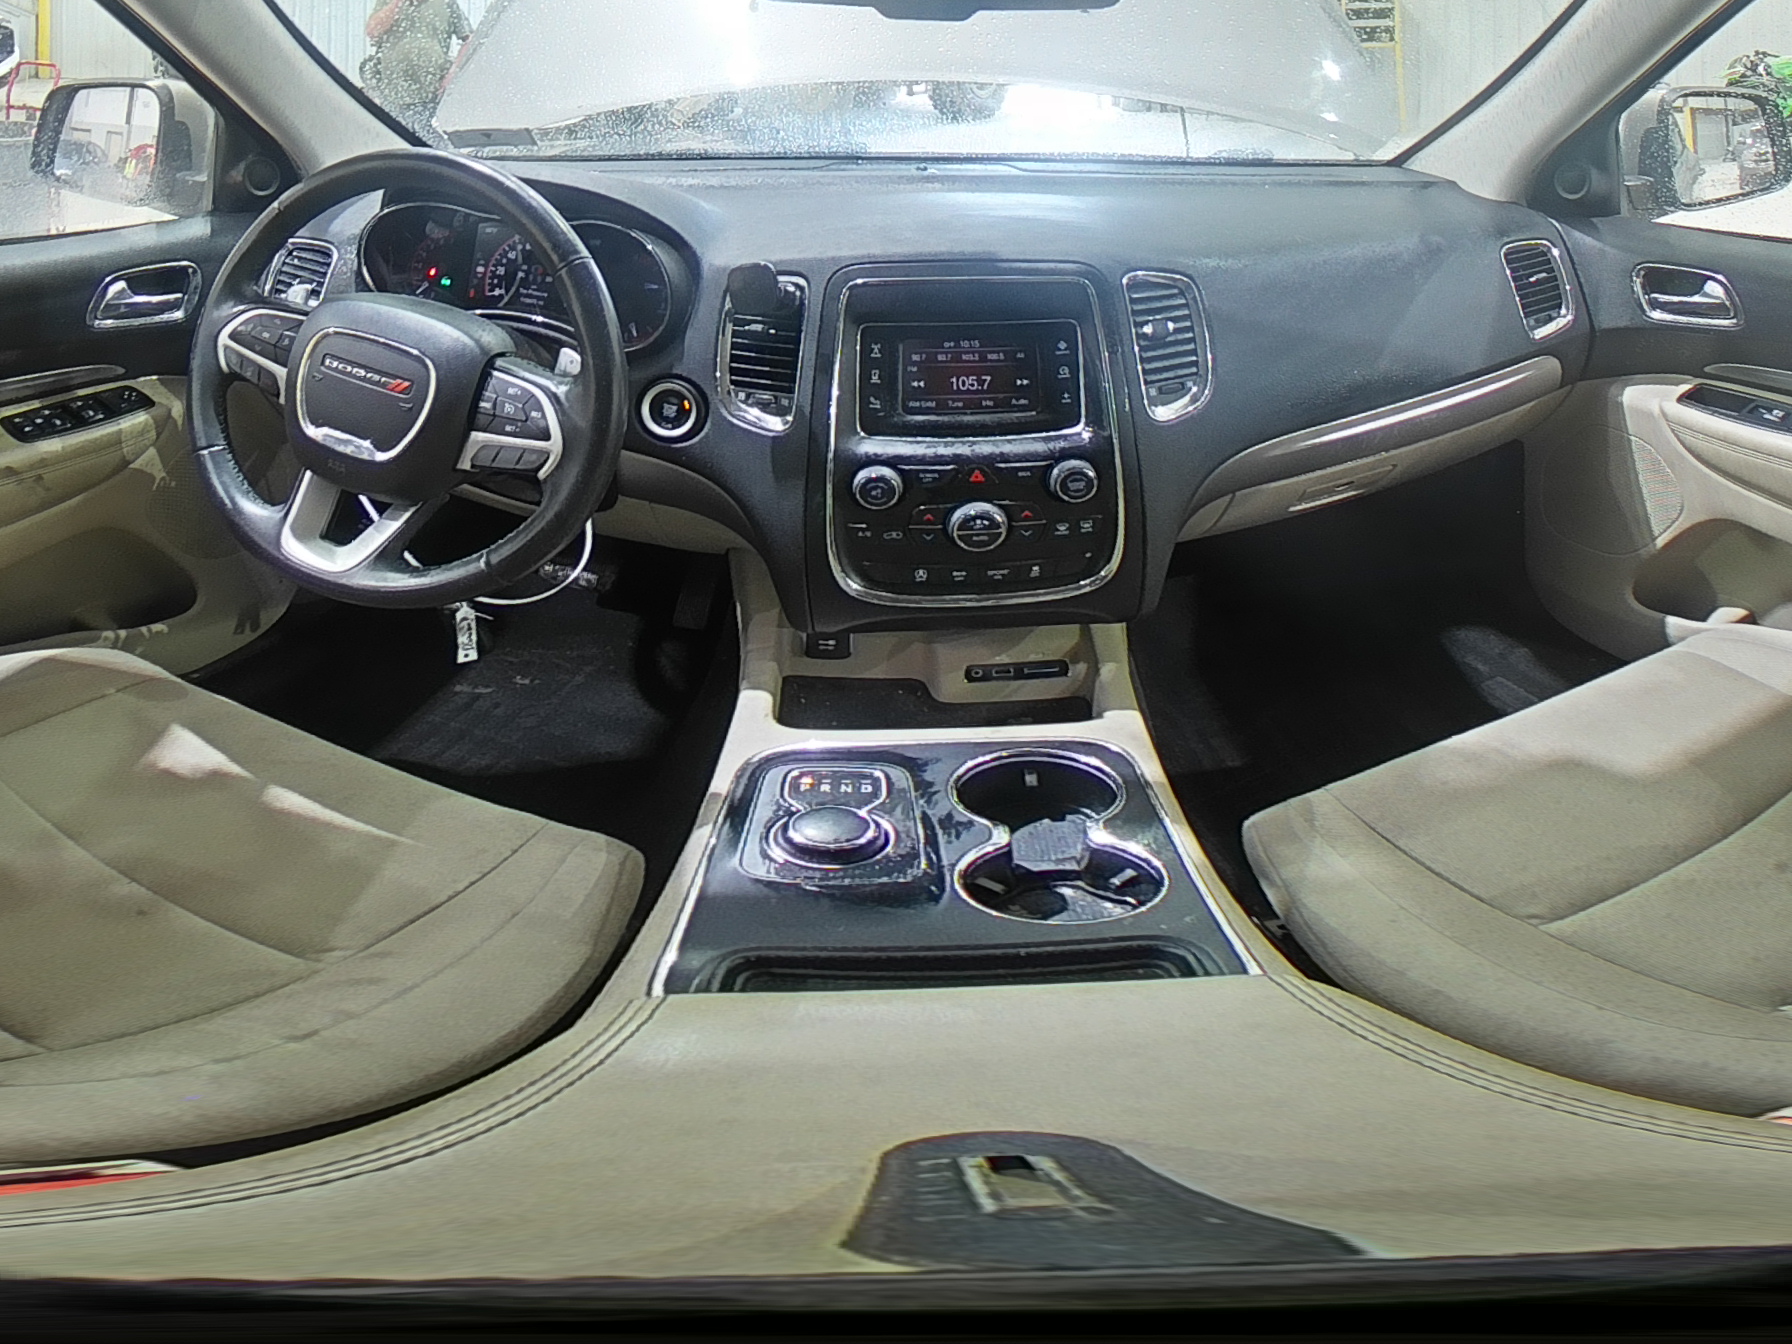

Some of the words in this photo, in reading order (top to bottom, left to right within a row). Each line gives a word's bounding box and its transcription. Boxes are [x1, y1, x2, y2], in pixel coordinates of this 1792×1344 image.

[325, 358, 395, 385] DODGE
[950, 375, 992, 391] 105.7
[820, 783, 832, 793] R
[840, 783, 852, 793] N
[860, 783, 873, 793] D
